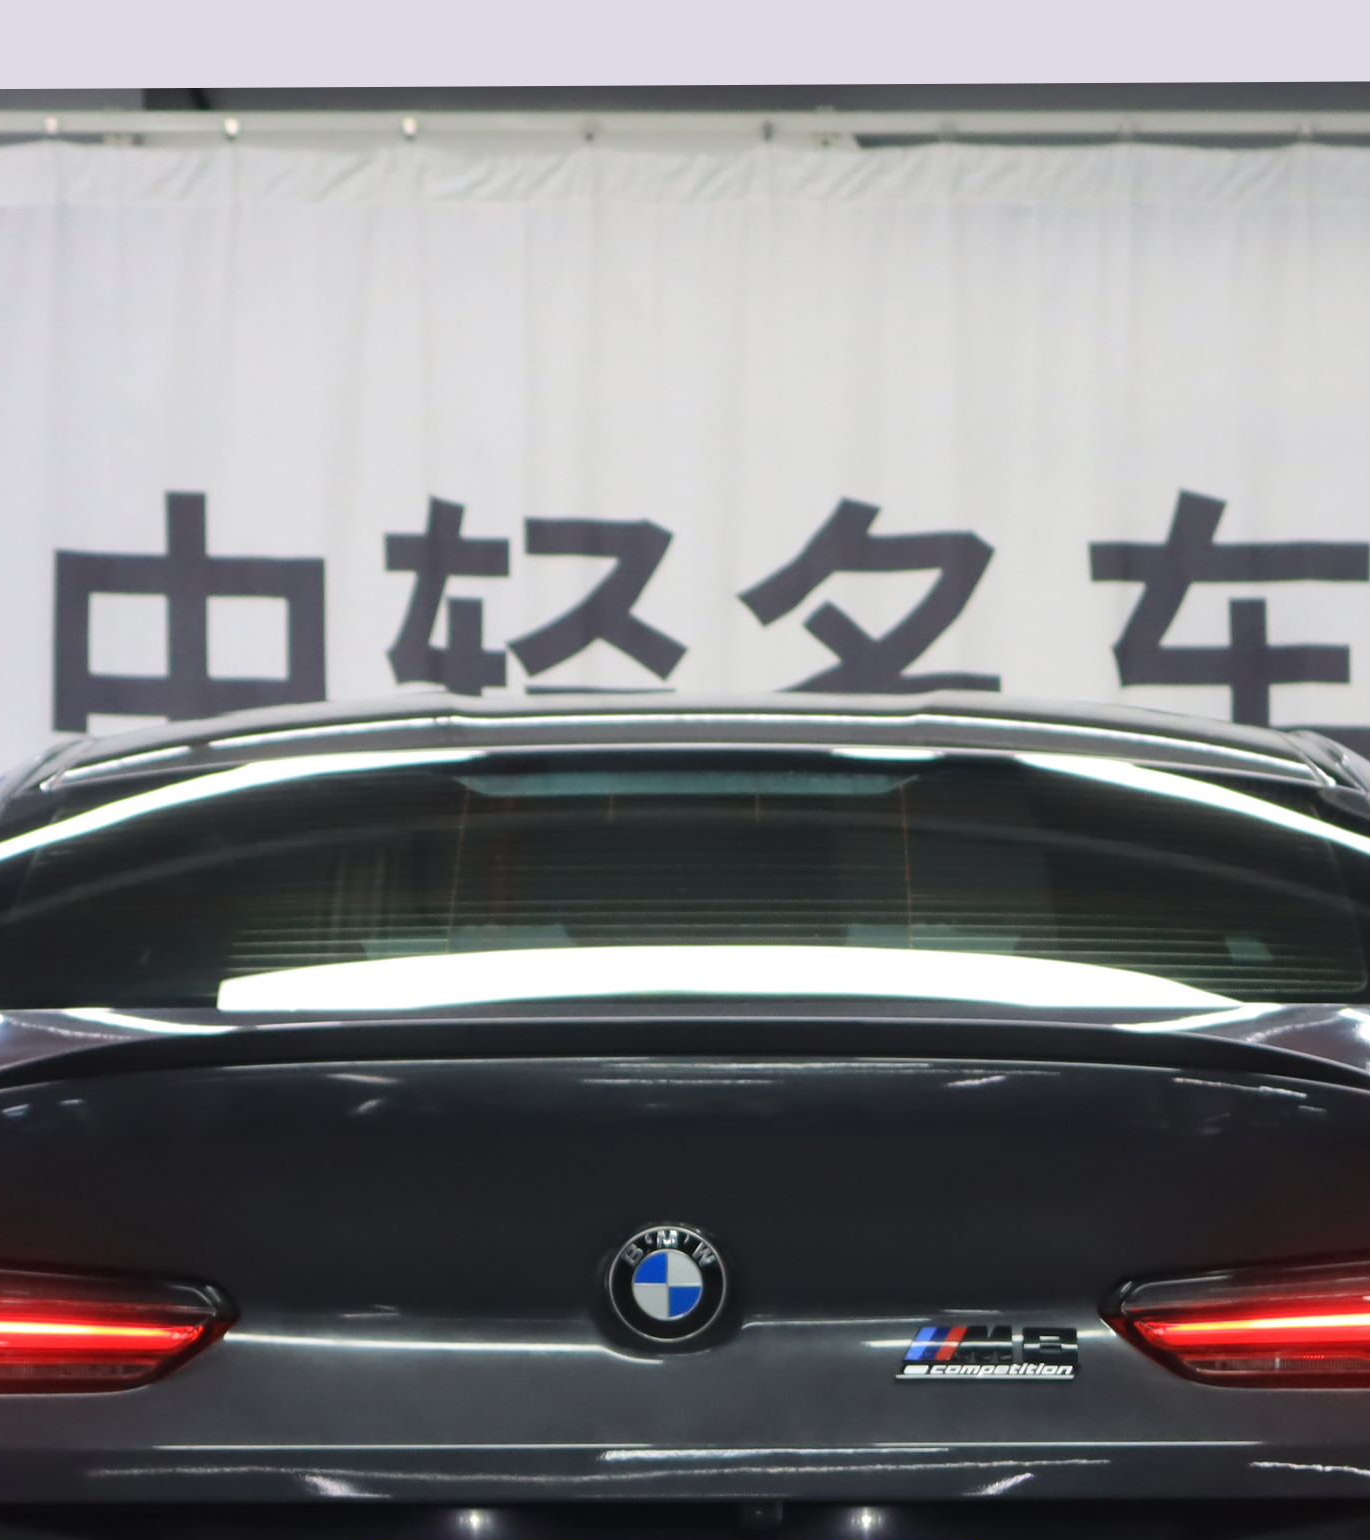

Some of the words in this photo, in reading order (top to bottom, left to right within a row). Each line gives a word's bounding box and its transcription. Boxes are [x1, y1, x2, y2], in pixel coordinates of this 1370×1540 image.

[620, 1228, 717, 1267] BMW
[947, 1325, 1079, 1363] M8
[930, 1362, 1075, 1377] competition
